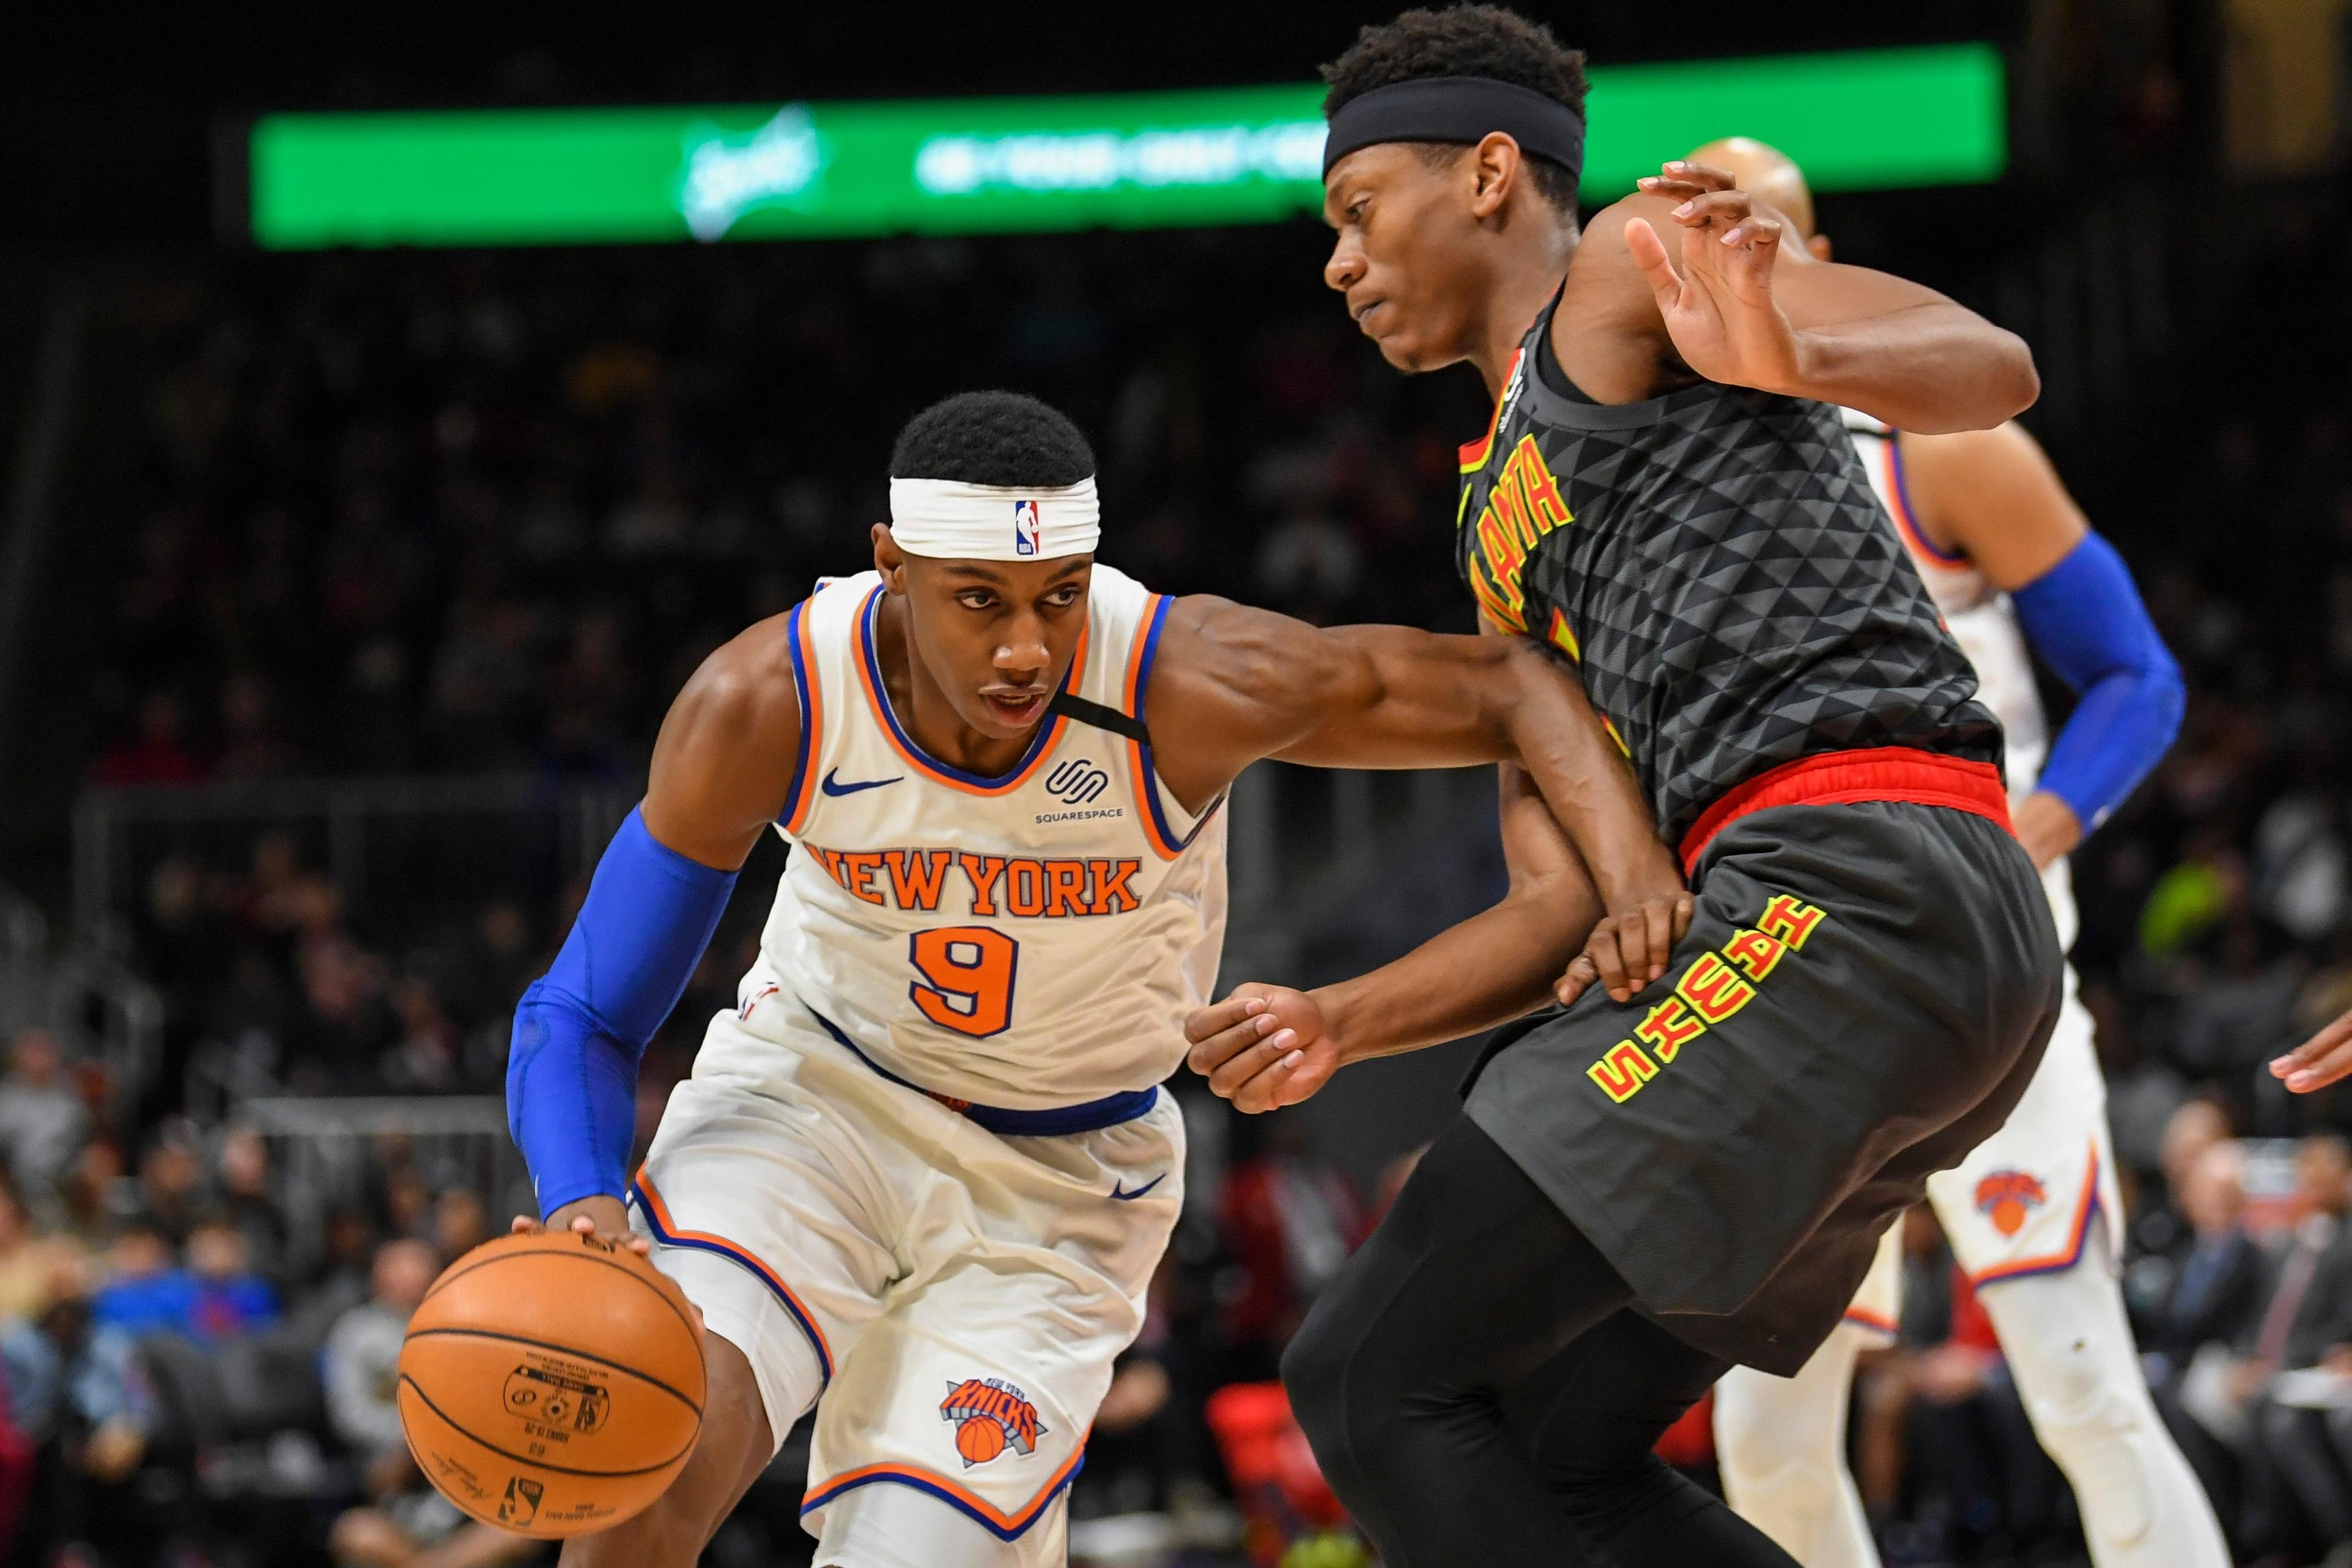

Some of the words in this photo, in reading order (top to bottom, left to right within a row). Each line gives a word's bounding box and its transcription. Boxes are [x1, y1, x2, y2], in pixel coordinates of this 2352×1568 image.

[1035, 808, 1123, 824] SQUARESPACE
[959, 852, 1142, 918] YORK
[908, 925, 1019, 1039] 9
[1585, 894, 1828, 1104] HAWKS
[940, 1379, 1038, 1452] KNICKS
